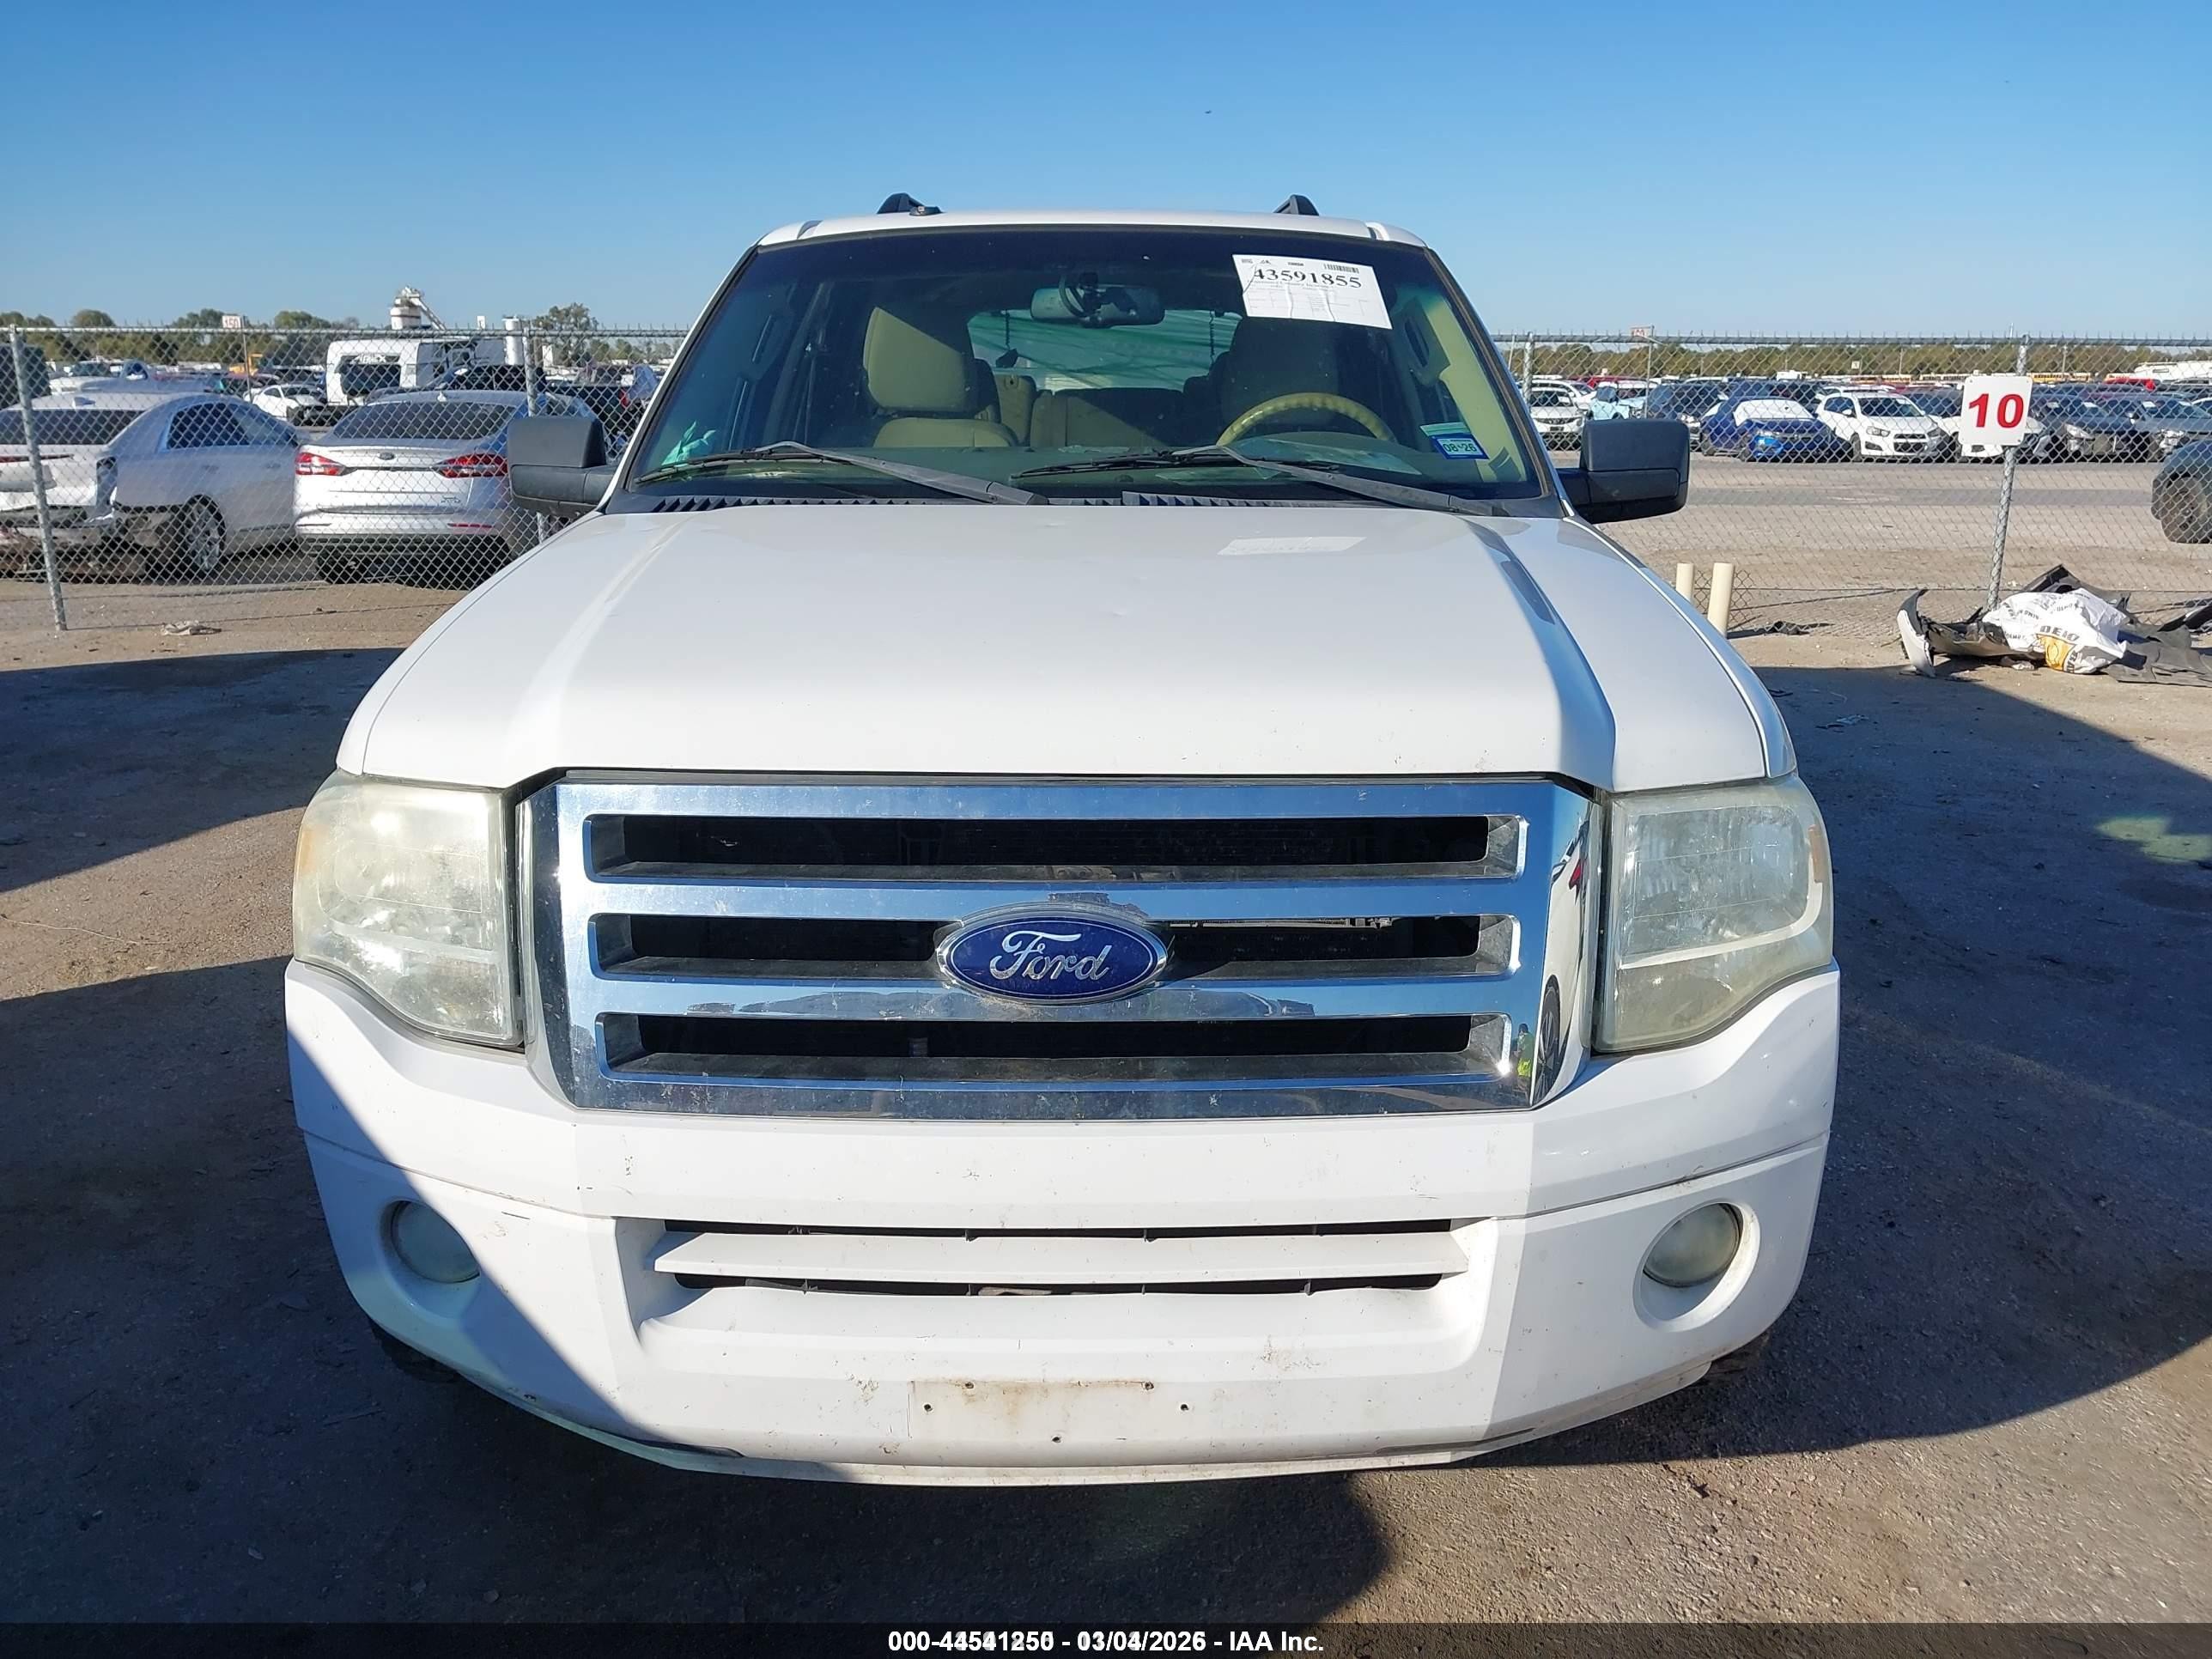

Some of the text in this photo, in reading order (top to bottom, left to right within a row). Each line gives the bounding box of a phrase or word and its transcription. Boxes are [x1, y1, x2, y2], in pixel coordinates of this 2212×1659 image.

[1255, 268, 1362, 289] 43591855
[1968, 393, 2024, 428] 10
[990, 930, 1114, 981] Ford
